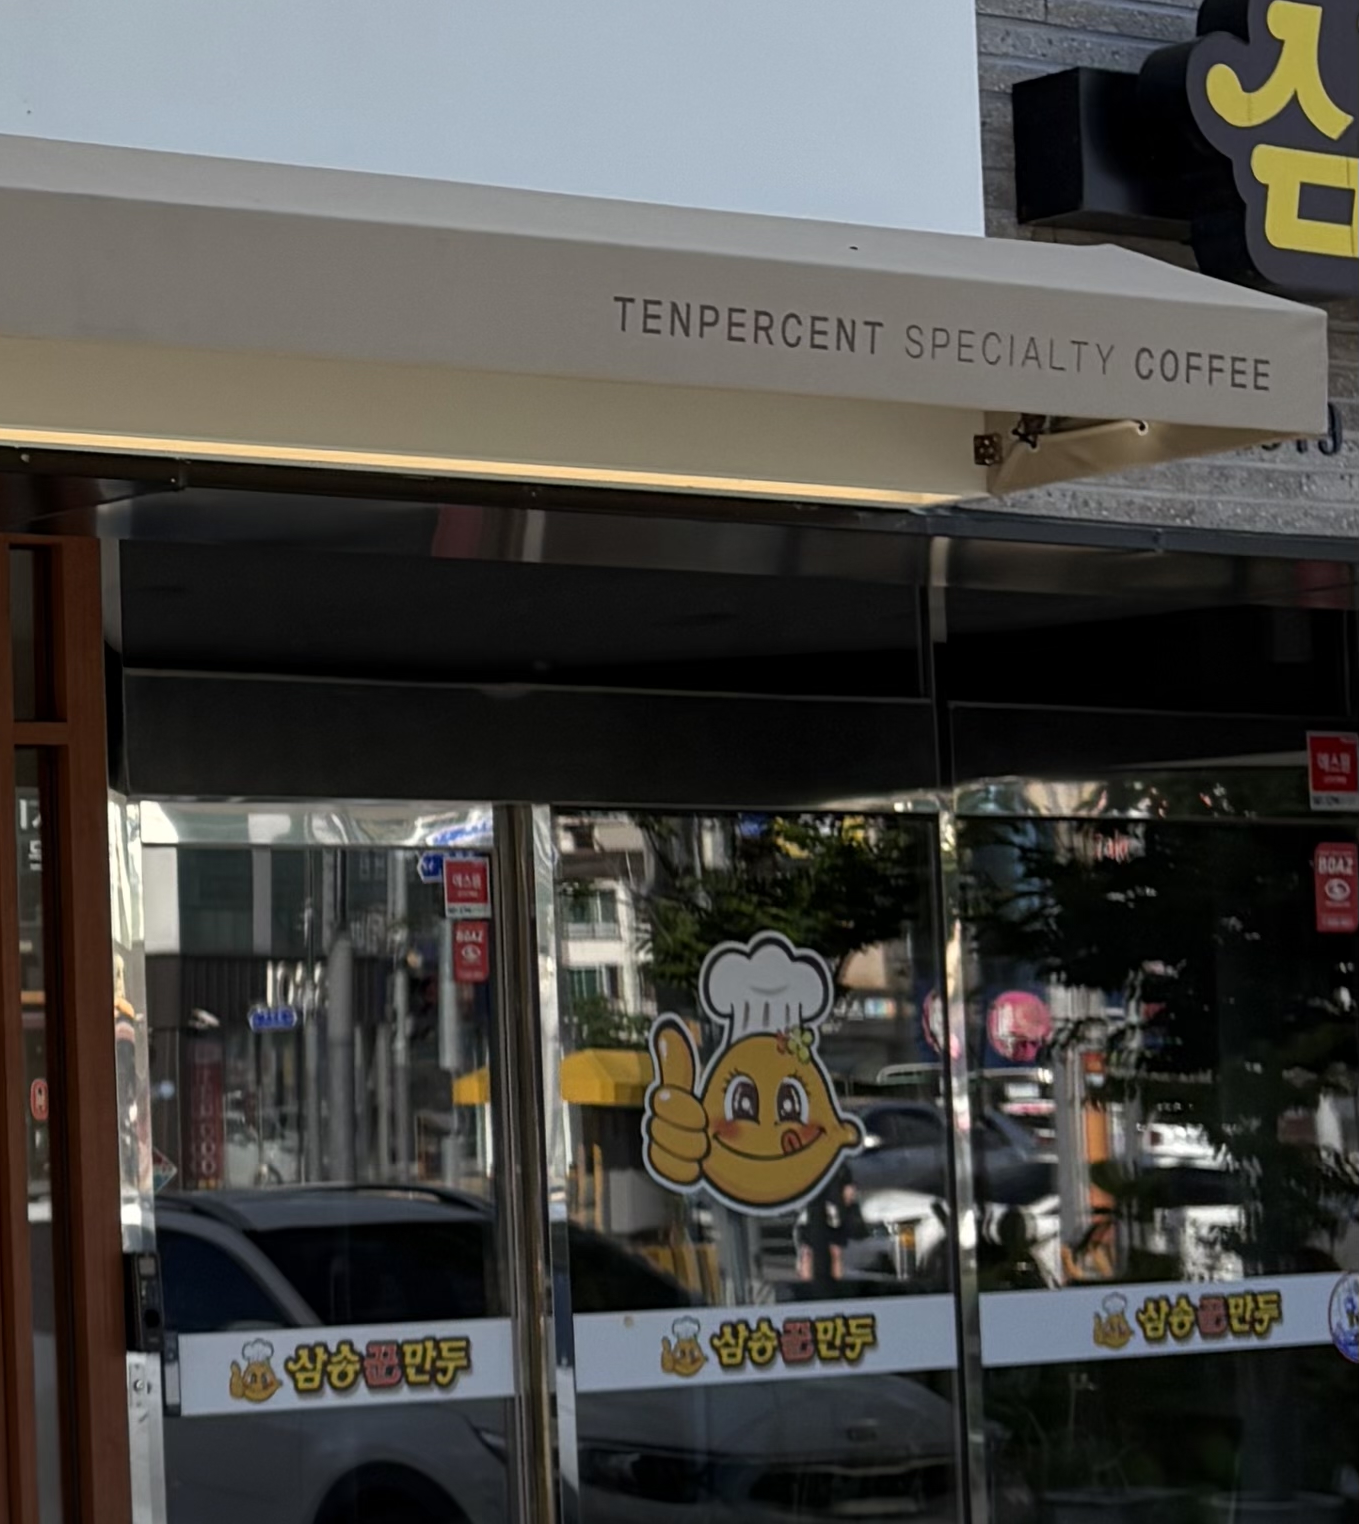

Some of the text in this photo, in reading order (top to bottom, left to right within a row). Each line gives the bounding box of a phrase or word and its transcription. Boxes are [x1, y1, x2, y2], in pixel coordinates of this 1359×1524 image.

[612, 294, 1273, 394] TENPERCENT SPECIALTY COFFEE
